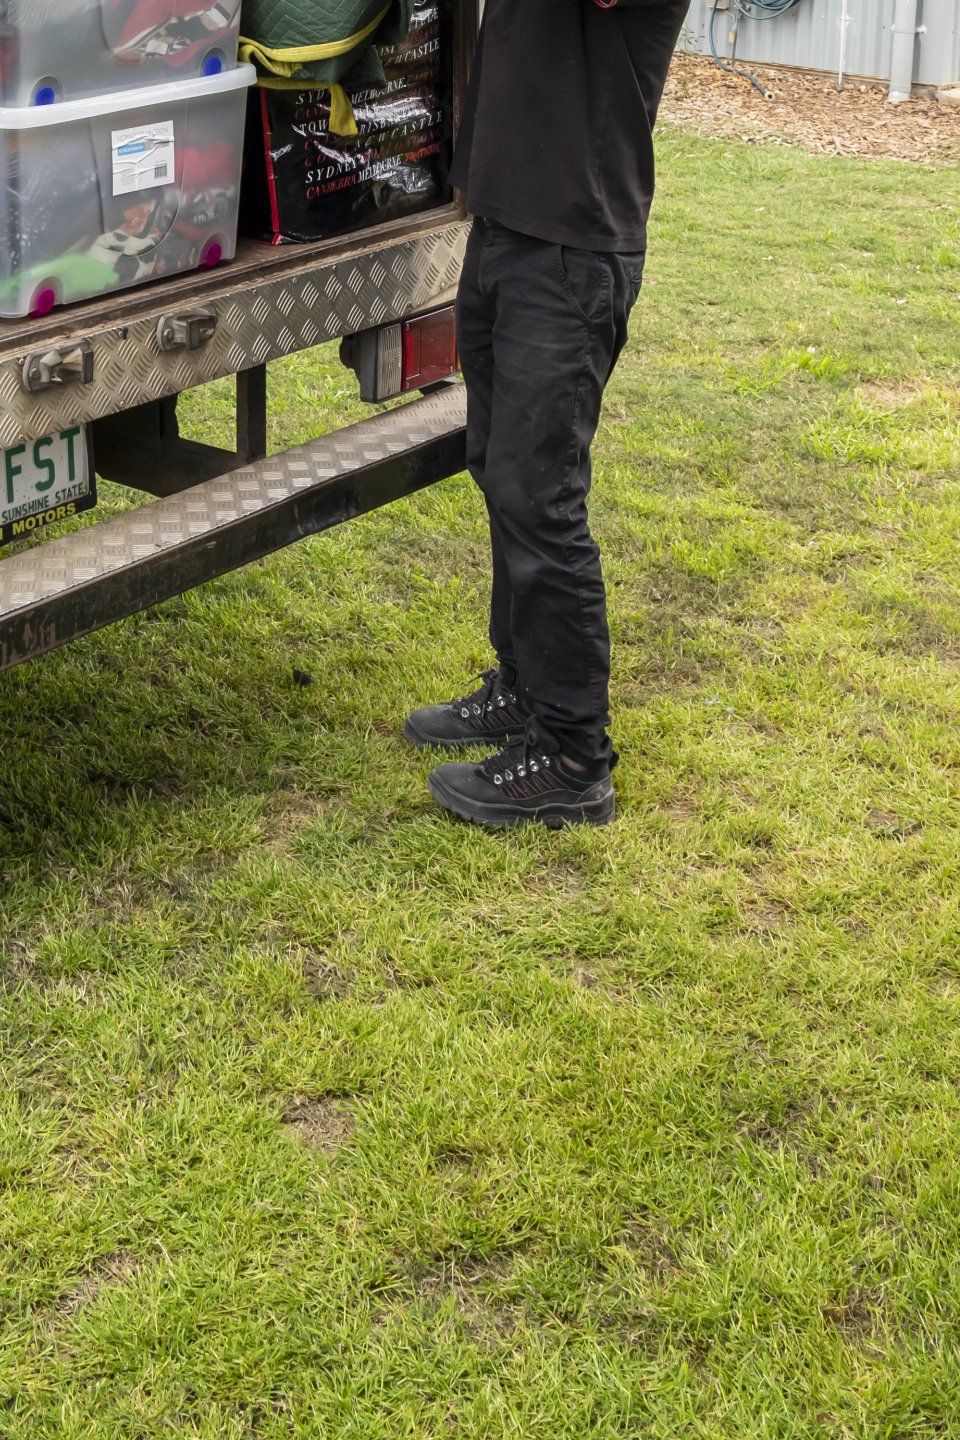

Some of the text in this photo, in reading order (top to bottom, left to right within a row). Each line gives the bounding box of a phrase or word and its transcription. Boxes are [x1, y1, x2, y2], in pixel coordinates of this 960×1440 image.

[305, 156, 358, 184] SYDNEY
[1, 495, 50, 525] SUNSHINE
[55, 483, 85, 504] STATE
[12, 502, 77, 536] MOTORS
